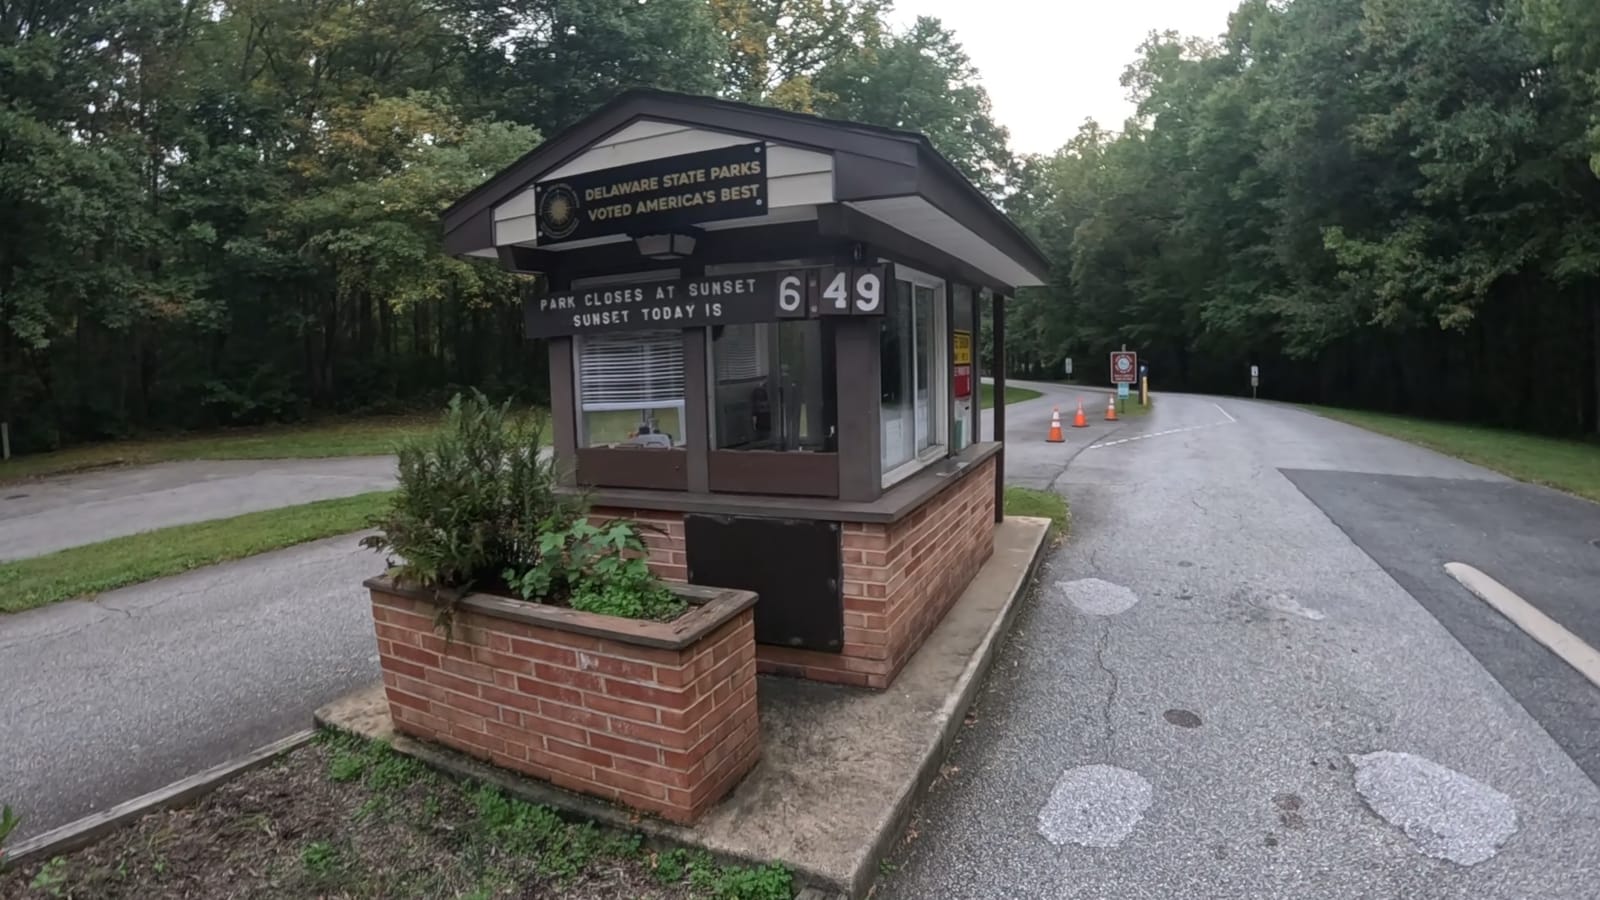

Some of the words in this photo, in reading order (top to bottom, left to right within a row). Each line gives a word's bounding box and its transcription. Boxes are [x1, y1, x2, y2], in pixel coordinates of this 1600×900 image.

[585, 177, 659, 201] DELAWARE
[663, 169, 705, 188] STATE
[710, 161, 761, 180] PARKS
[588, 205, 632, 222] VOTED
[636, 191, 716, 214] AMERICA'S
[721, 184, 760, 201] BEST
[540, 296, 576, 311] PARK
[585, 288, 643, 307] CLOSES
[656, 286, 675, 300] AT
[689, 279, 756, 297] SUNSET
[573, 310, 629, 327] SUNSET
[641, 304, 695, 321] TODAY
[705, 303, 722, 317] IS
